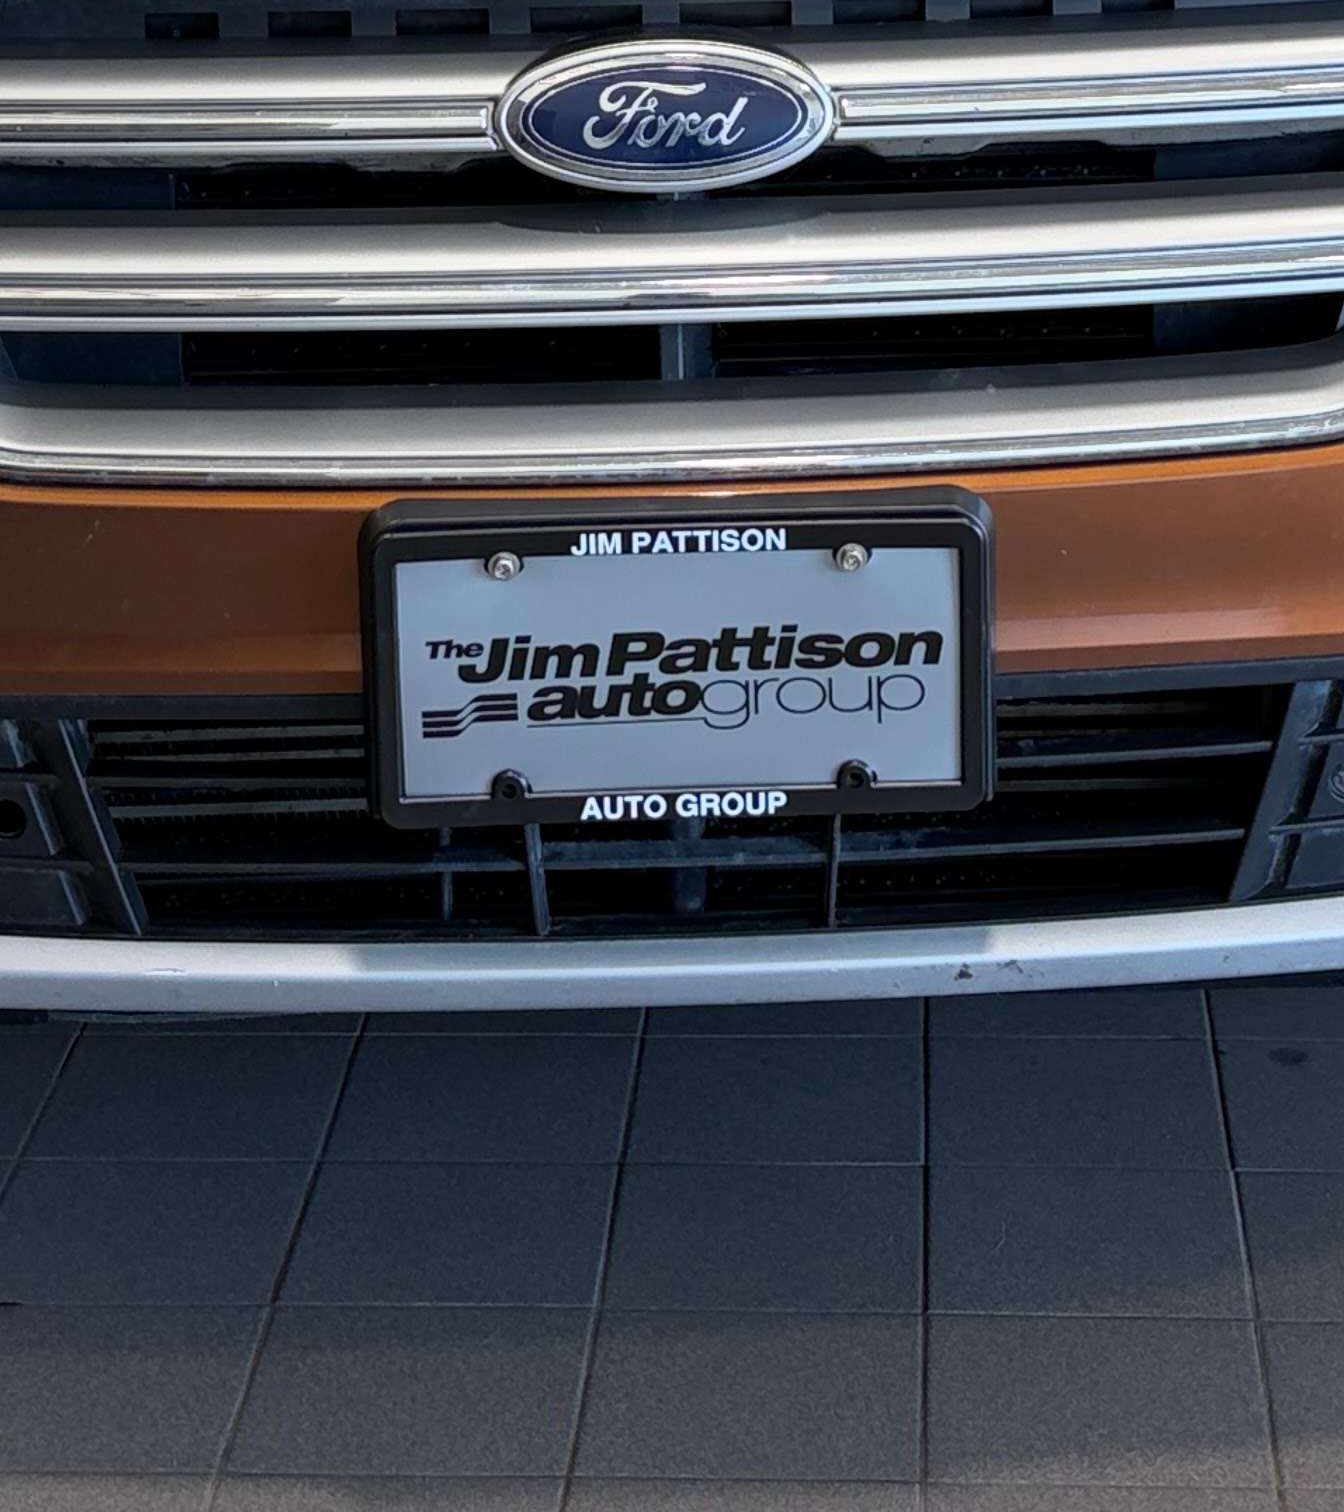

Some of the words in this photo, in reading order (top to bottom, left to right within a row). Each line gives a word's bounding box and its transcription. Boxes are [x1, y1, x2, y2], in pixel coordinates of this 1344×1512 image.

[582, 80, 749, 150] Ford
[570, 531, 622, 556] JIM
[631, 527, 787, 554] PATTISON
[425, 639, 485, 660] The
[605, 624, 945, 677] Pattison
[580, 793, 668, 821] AUTO
[675, 790, 788, 818] GROUP
